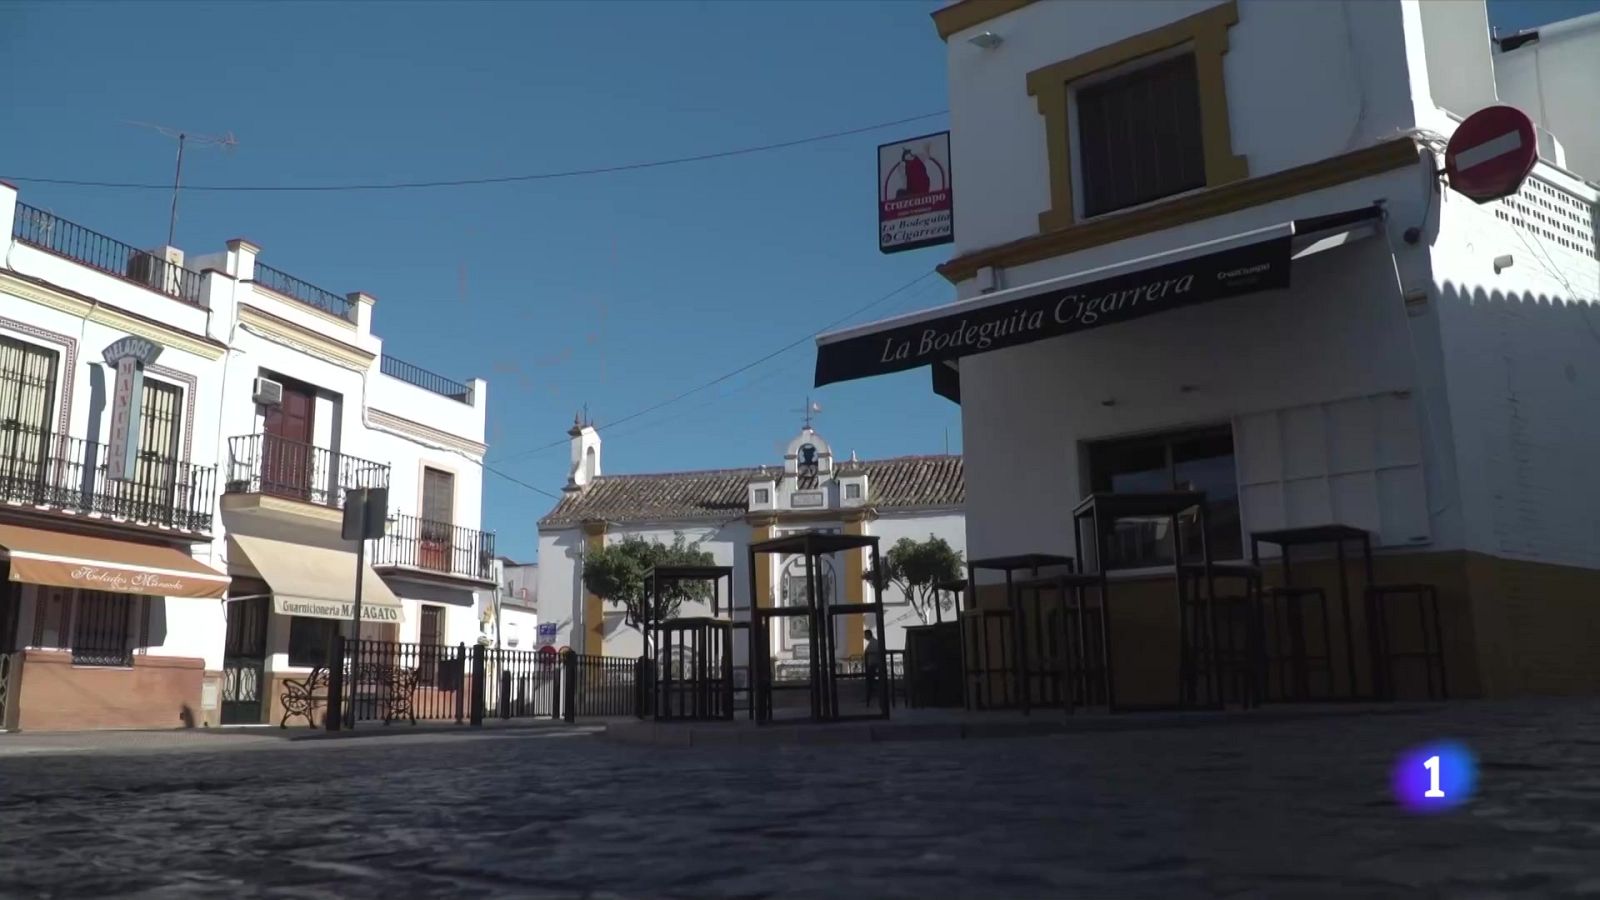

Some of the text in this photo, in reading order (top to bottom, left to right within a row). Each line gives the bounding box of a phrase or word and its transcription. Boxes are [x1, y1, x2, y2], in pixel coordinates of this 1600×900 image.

[880, 271, 1195, 363] La Bodeguita Cigarrera
[107, 340, 148, 369] HELADOS
